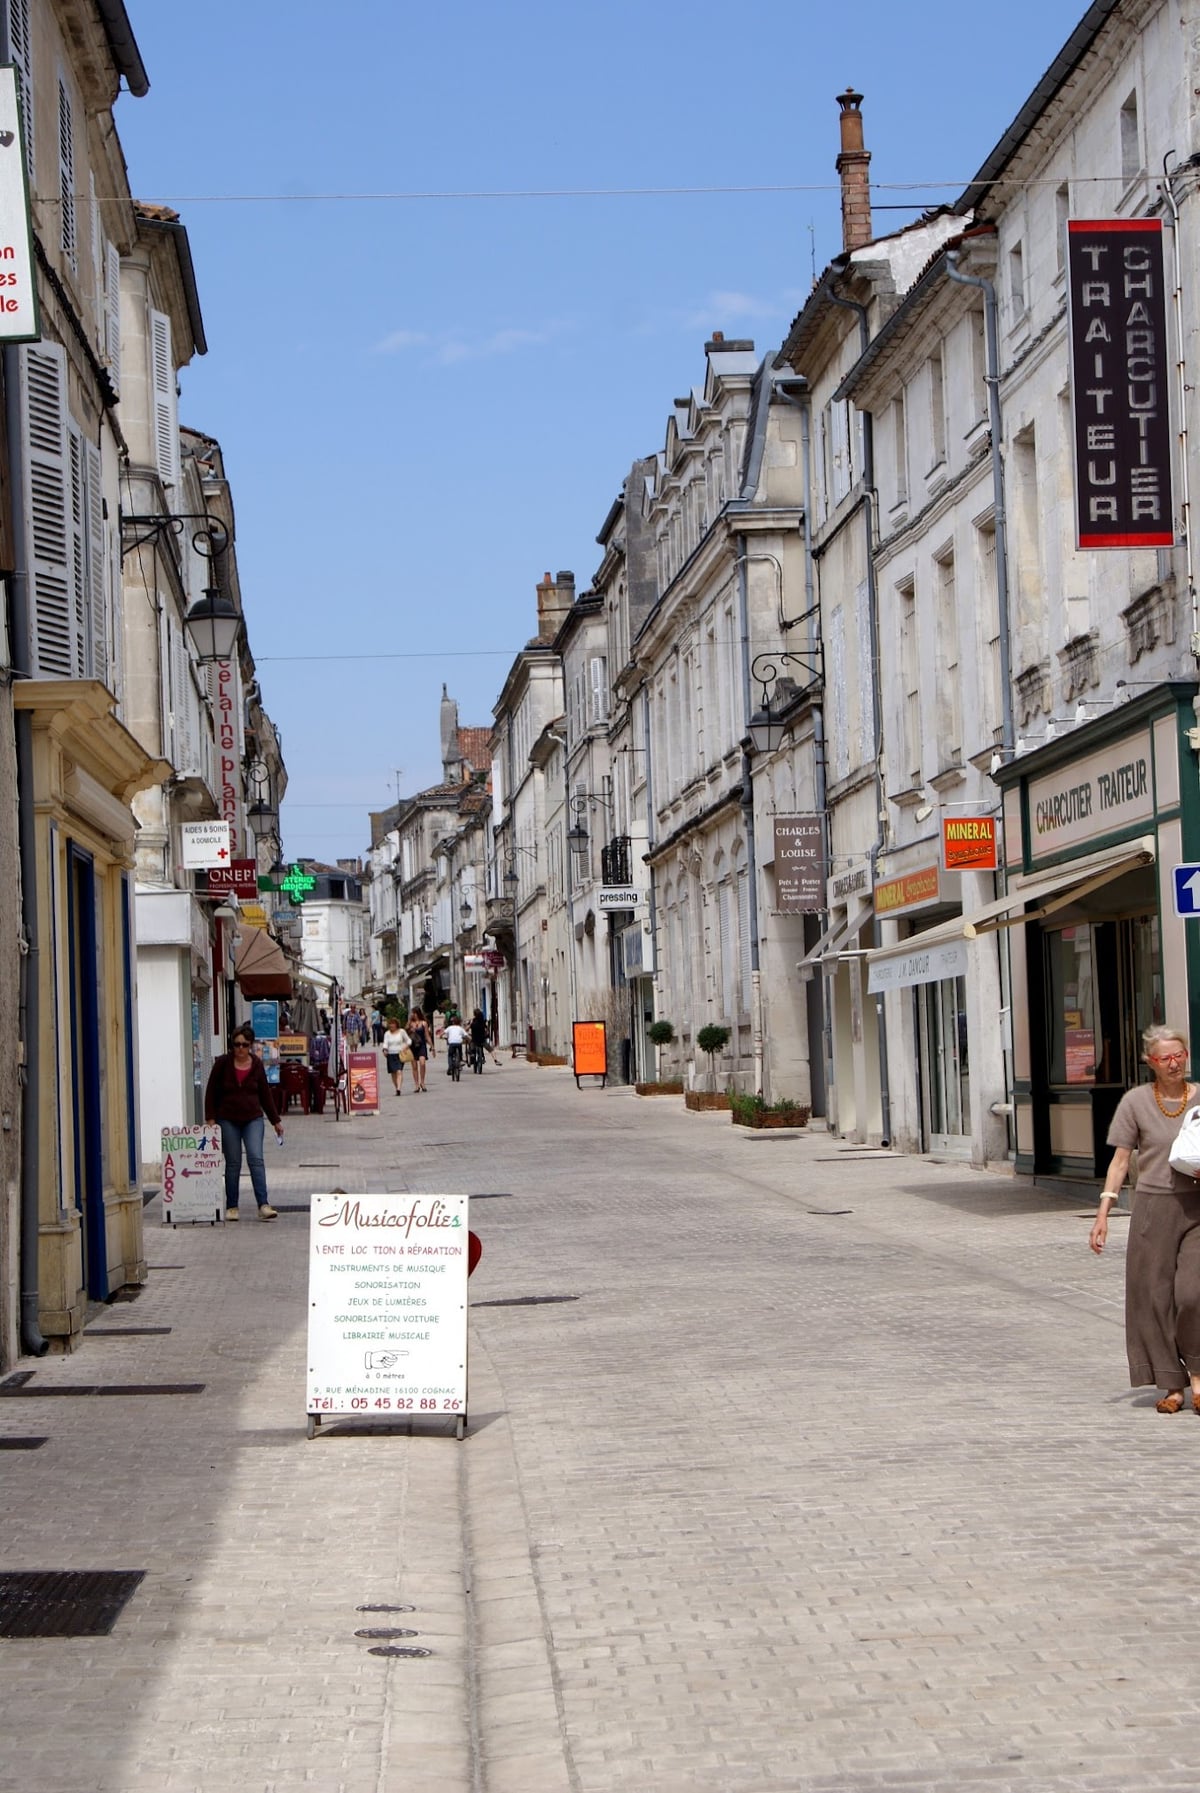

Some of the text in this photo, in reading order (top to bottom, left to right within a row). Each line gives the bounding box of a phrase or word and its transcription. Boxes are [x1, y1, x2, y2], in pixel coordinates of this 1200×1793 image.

[1081, 245, 1118, 521] TRAITEUR
[1123, 247, 1160, 520] CHARCUTIER
[1036, 758, 1148, 834] CHARCUTIER TRAITEUR
[184, 826, 203, 834] AIDES
[775, 826, 821, 836] CHARLES
[947, 822, 993, 840] MINERAL
[794, 838, 802, 847] &
[781, 848, 817, 858] LOUISE
[599, 891, 638, 904] pressing
[876, 881, 905, 911] MINERAL
[163, 1153, 176, 1203] ADOS
[318, 1200, 463, 1239] Musicofolies
[399, 1246, 404, 1255] &
[407, 1243, 462, 1255] RÉPARATION
[406, 1265, 446, 1273] MUSIQUE
[354, 1281, 421, 1289] SONORISATION
[347, 1296, 427, 1306] JEUX DE LUMIÈRES
[334, 1315, 440, 1323] SONORISATION VOITURE
[342, 1332, 430, 1340] LIBRAIRIE MUSICALE
[345, 1385, 391, 1394] MÉNADINE
[350, 1398, 368, 1409] 05
[374, 1398, 391, 1409] 45
[397, 1398, 414, 1409] 82
[420, 1398, 437, 1409] 88
[443, 1398, 460, 1409] 26
